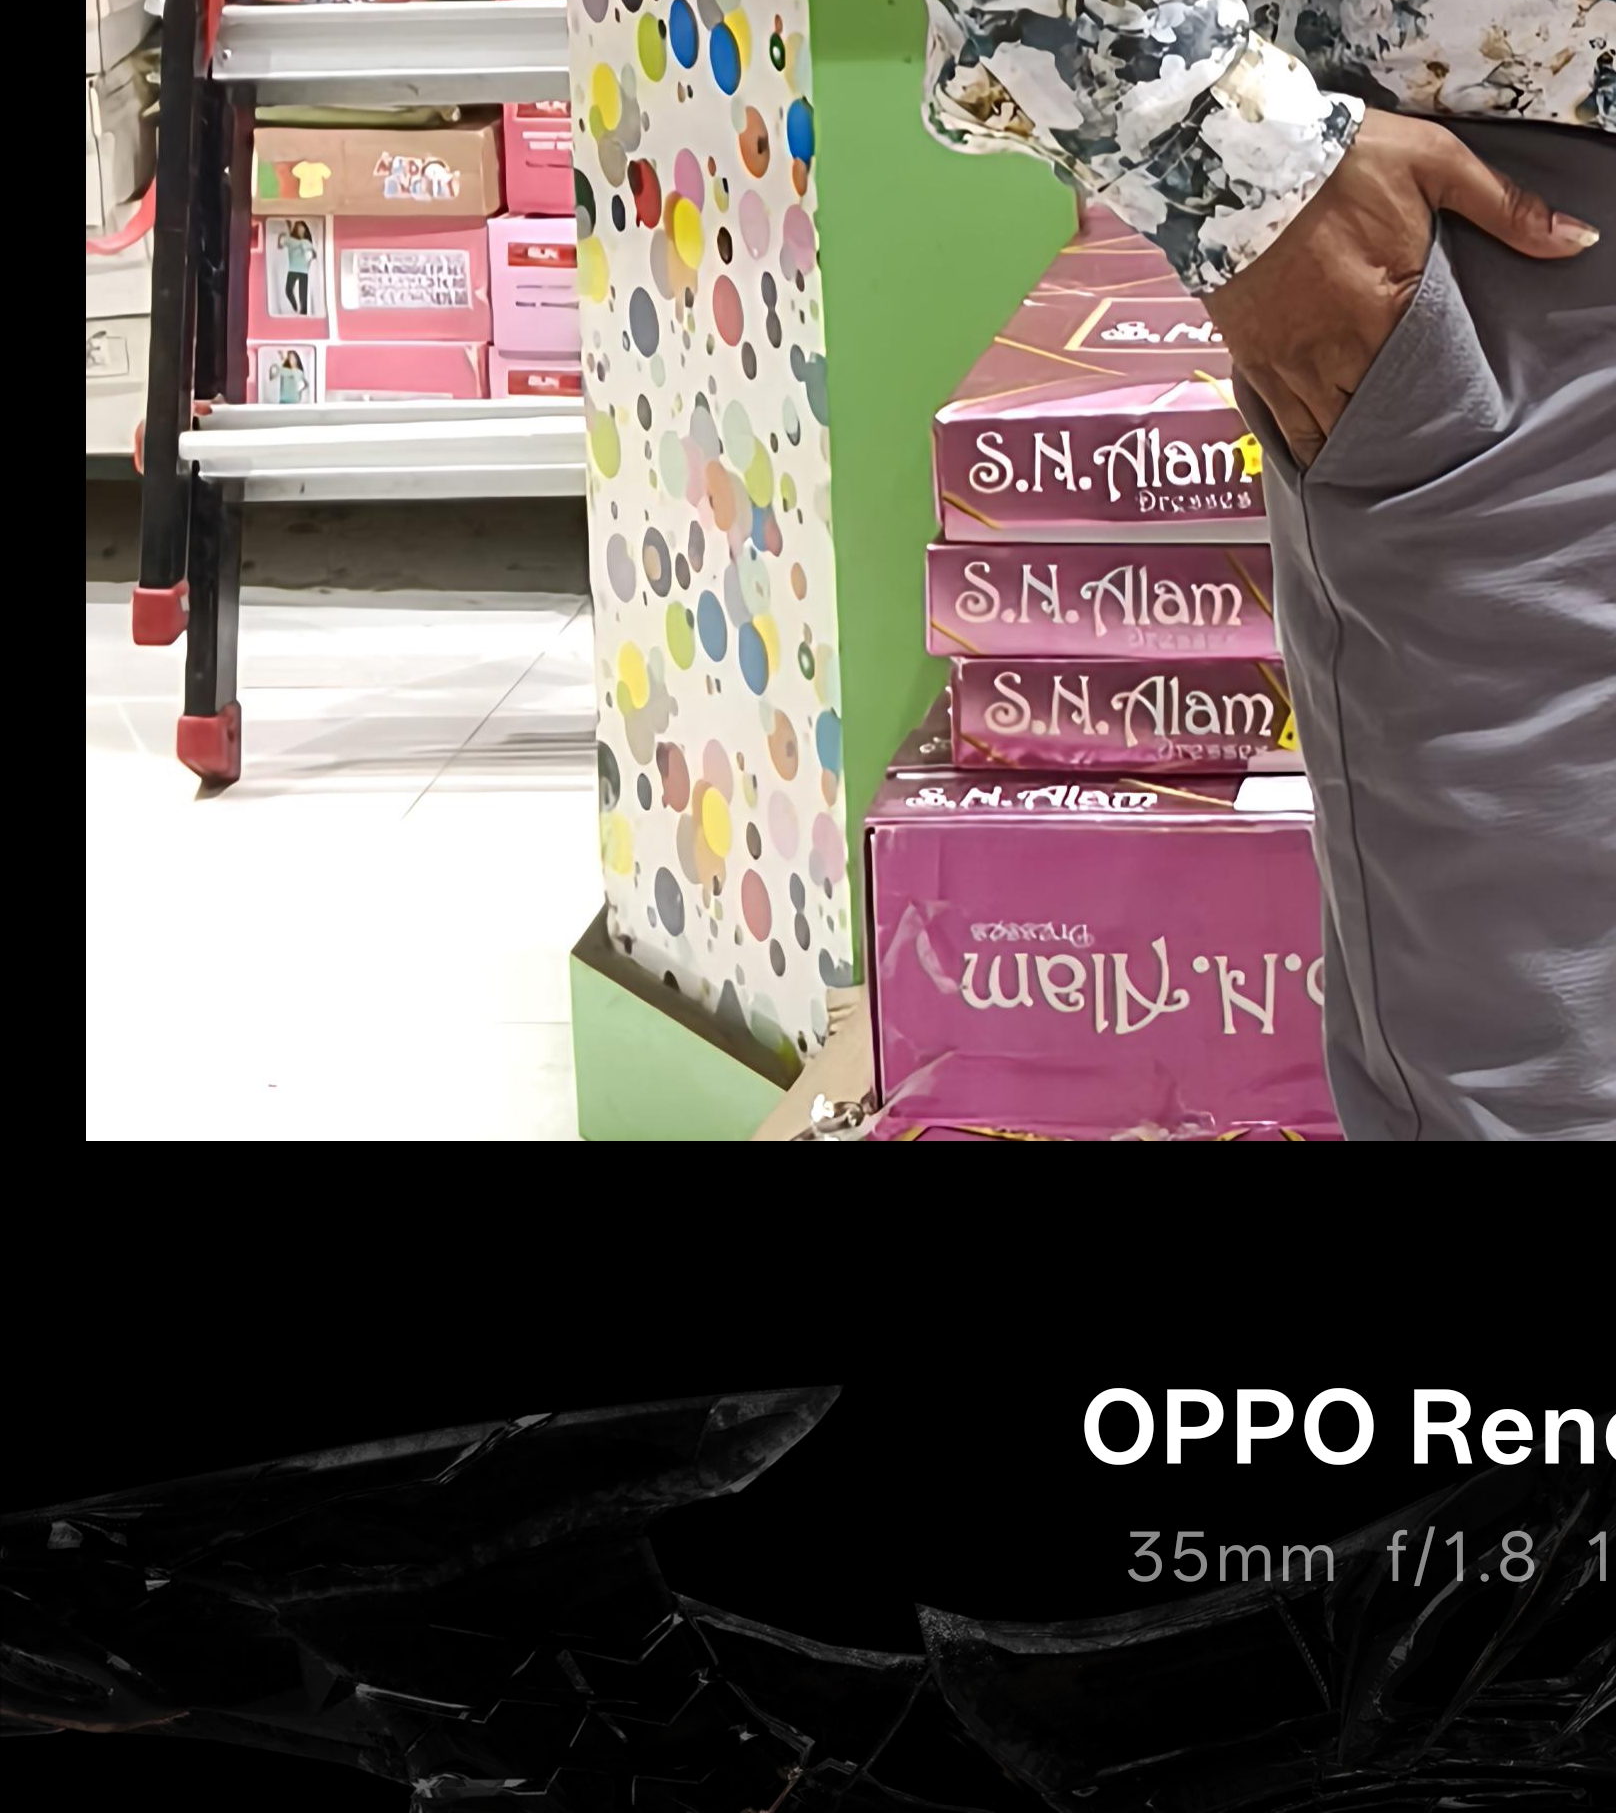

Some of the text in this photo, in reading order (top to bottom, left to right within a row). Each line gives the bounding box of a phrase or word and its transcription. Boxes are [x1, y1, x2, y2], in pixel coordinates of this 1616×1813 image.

[969, 427, 1253, 502] S.N.Alam
[955, 561, 1243, 637] S.N.Alam
[984, 671, 1275, 748] S.N.Alam
